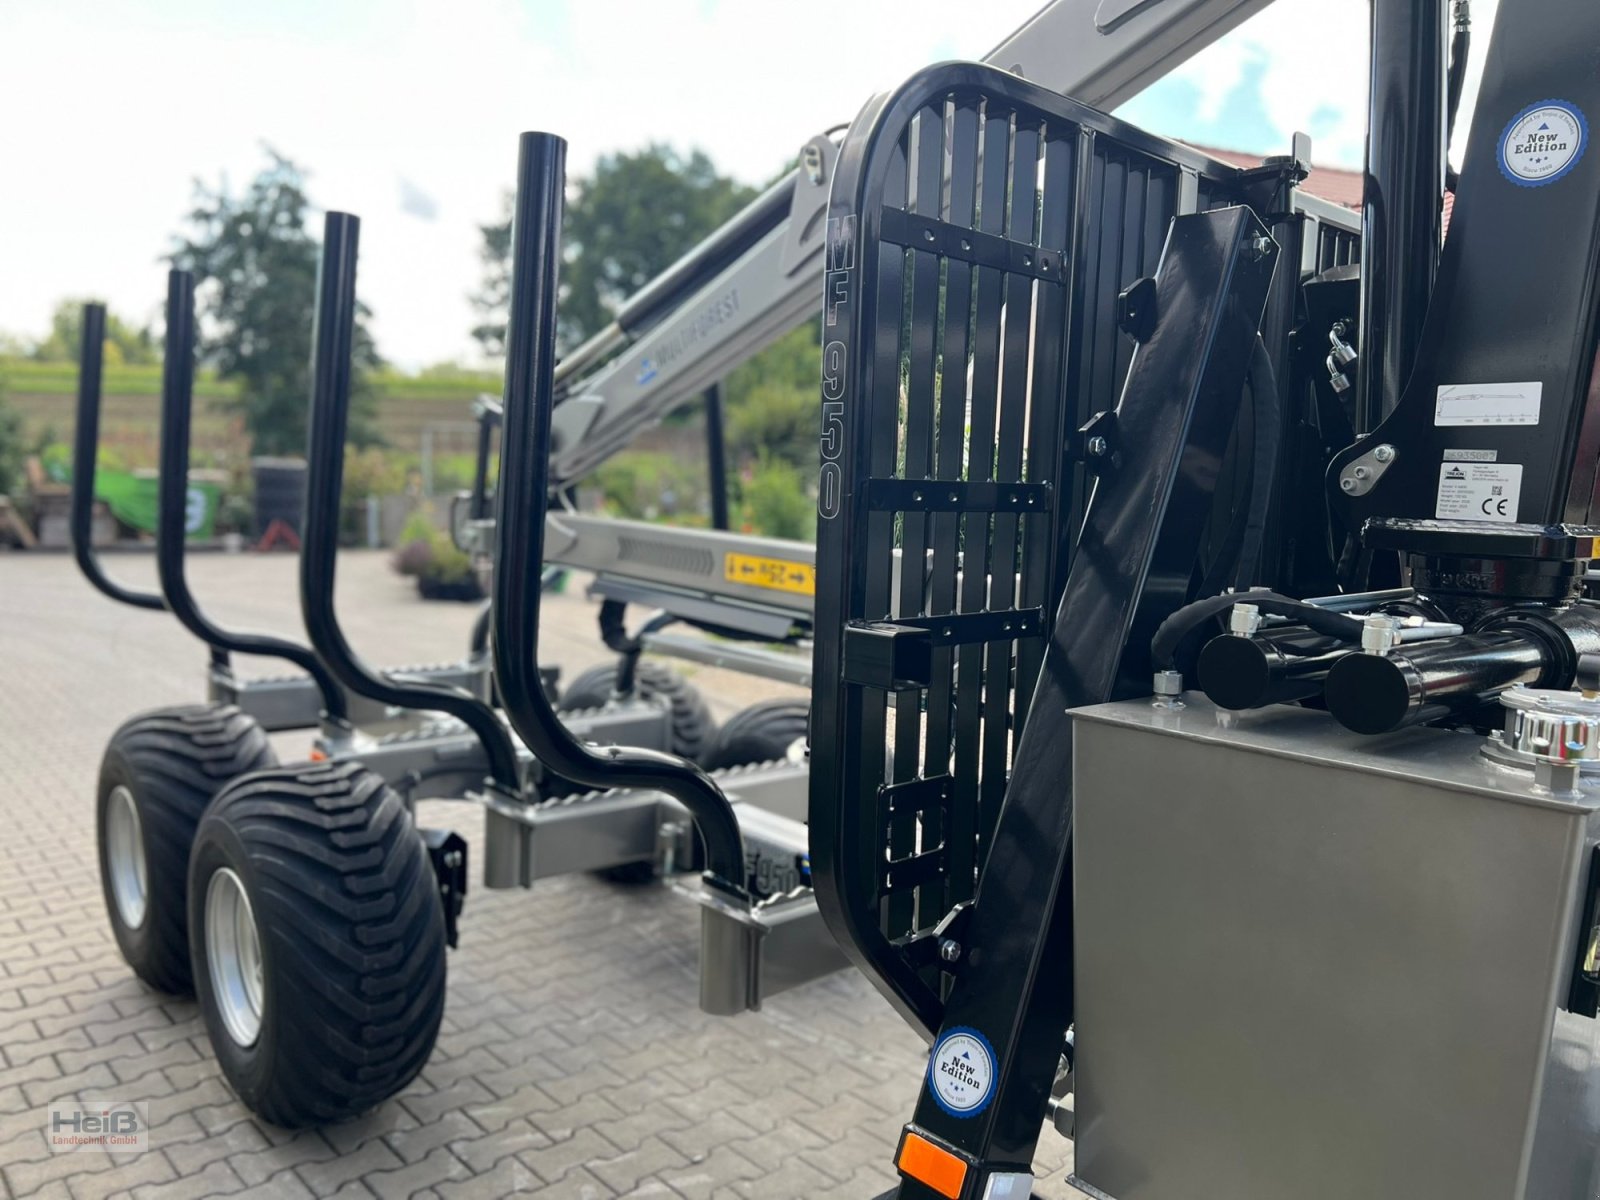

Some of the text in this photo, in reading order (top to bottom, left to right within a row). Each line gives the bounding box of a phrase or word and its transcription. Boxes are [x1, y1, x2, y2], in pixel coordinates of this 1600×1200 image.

[1527, 133, 1559, 143] New
[1514, 142, 1567, 154] Edition
[817, 214, 857, 520] MF 950
[1482, 498, 1509, 516] CE
[951, 1056, 976, 1075] New
[940, 1061, 981, 1090] Edition
